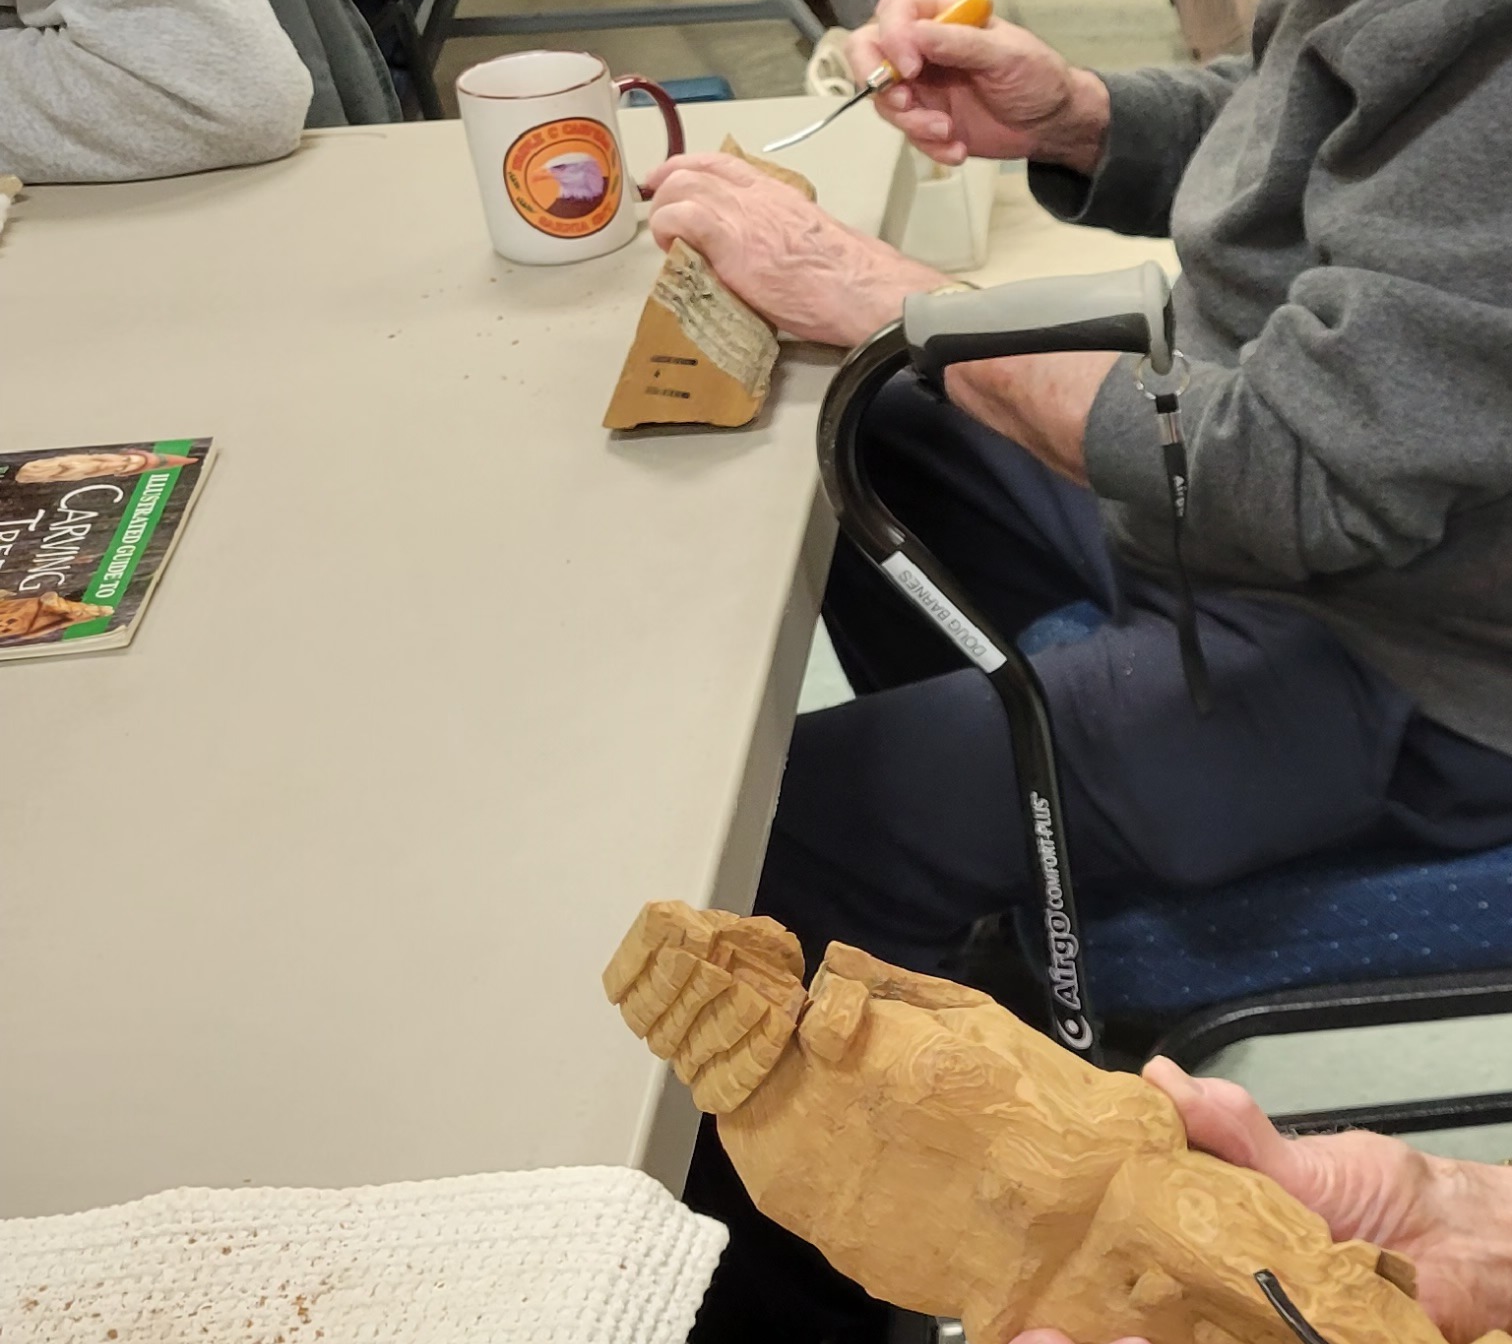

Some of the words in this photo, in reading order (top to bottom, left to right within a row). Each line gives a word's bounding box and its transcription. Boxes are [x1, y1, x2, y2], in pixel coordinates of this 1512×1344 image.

[122, 473, 170, 544] ILLUSTRATED
[19, 484, 124, 591] CARVING
[104, 545, 136, 582] GUIDE
[95, 583, 120, 598] TO
[899, 570, 951, 621] BARNES
[948, 619, 987, 657] DOUG
[1046, 910, 1081, 1010] Airgo
